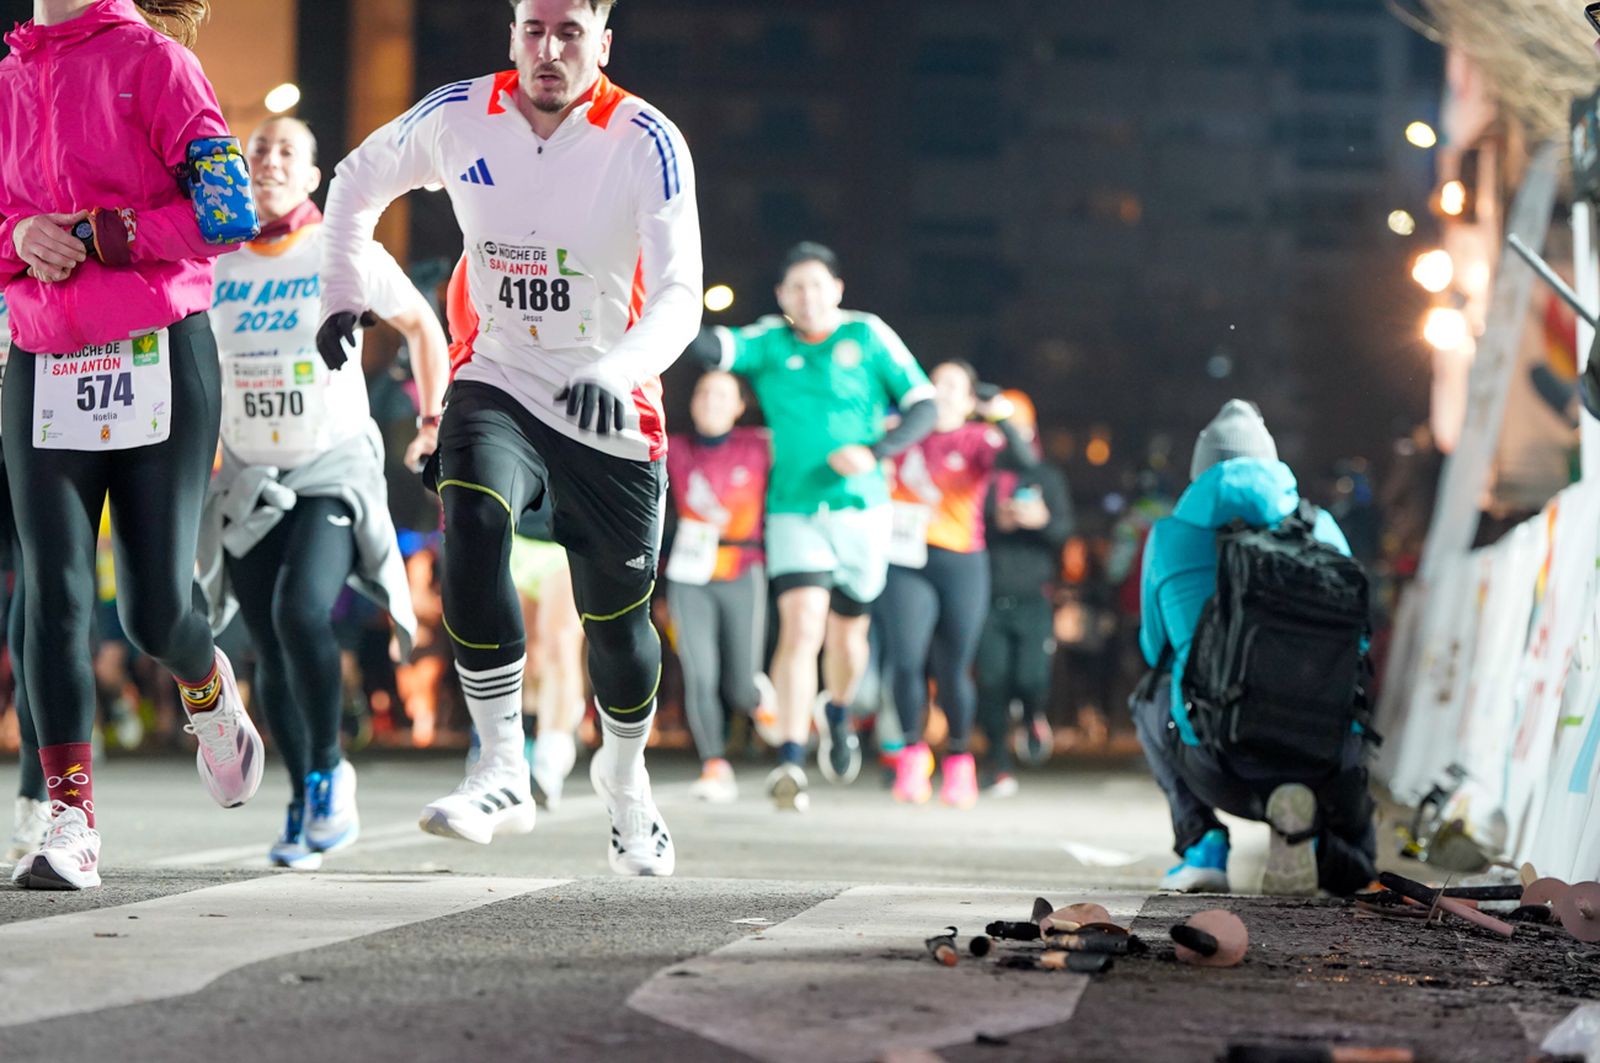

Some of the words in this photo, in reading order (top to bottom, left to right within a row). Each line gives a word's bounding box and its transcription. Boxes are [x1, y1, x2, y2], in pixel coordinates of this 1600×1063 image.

[499, 247, 531, 260] NOCHE
[533, 250, 547, 261] DE
[489, 258, 507, 273] SAN
[509, 261, 548, 276] ANTÓN
[213, 280, 253, 308] SAN
[498, 276, 571, 312] 4188
[234, 309, 299, 333] 2026
[522, 313, 543, 322] Jesus
[105, 342, 120, 354] DE
[52, 361, 78, 376] SAN
[81, 355, 121, 373] ANTÓN
[77, 372, 135, 411] 574
[244, 390, 304, 418] 6570
[93, 412, 118, 422] Noelia
